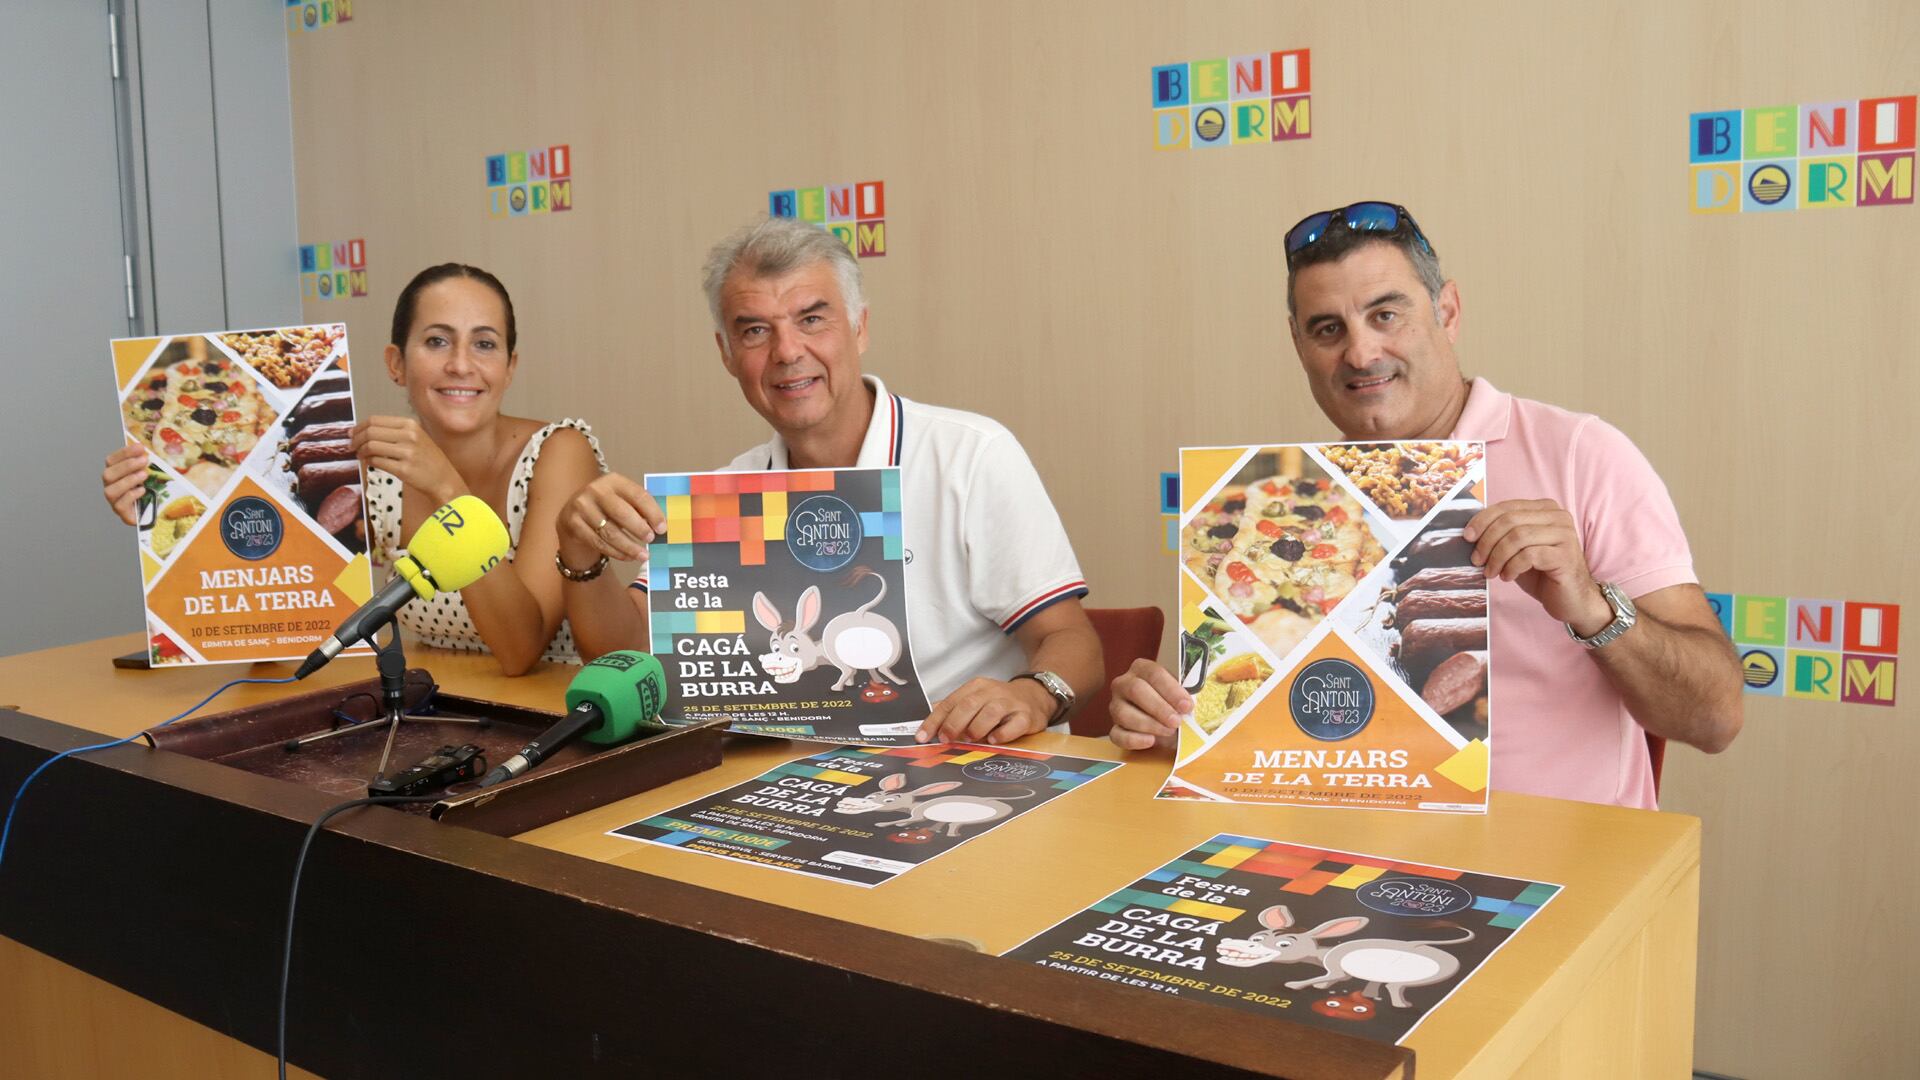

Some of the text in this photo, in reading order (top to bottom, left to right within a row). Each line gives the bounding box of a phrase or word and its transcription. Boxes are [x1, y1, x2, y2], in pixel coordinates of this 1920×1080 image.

[1157, 52, 1302, 105] BENI
[1157, 98, 1310, 146] DORM
[1697, 102, 1902, 158] BENI
[488, 147, 568, 184] BENI
[1695, 156, 1912, 208] DORM
[771, 183, 883, 220] BENI
[818, 508, 842, 521] SANT
[797, 514, 850, 545] ANTONI
[200, 565, 314, 589] MENJARS
[674, 573, 728, 588] Festa
[184, 589, 335, 615] DE LA TERRA
[675, 592, 723, 608] de la
[191, 620, 331, 637] 10 DE SETEMBRE DE 2022
[1707, 597, 1883, 648] ENI
[202, 639, 232, 649] ERMITA
[234, 638, 246, 647] DE
[277, 635, 323, 645] BENIDORM
[677, 635, 750, 656] CAGÁ
[679, 660, 758, 678] DE LA
[1741, 648, 1895, 700] ORM
[681, 680, 777, 698] BURRA
[1326, 673, 1351, 689] SANT
[703, 704, 719, 712] DE
[724, 701, 798, 711] SETEMBRE
[801, 701, 819, 709] DE
[822, 700, 853, 708] 2022
[1302, 678, 1360, 712] ANTONI
[830, 757, 883, 768] Festa
[841, 764, 862, 773] la
[1252, 750, 1408, 769] MENJARS
[778, 777, 853, 796] CAGÁ
[1221, 772, 1432, 788] DE LA TERRA
[753, 786, 831, 806] DE LA
[1268, 789, 1356, 798] SETEMBRE
[707, 811, 741, 820] PARTIR
[732, 794, 826, 817] BURRA
[690, 813, 725, 823] ERMITA
[772, 829, 828, 842] BENIDORM
[725, 807, 748, 815] DE
[746, 811, 820, 828] SETEMBRE
[818, 824, 840, 833] DE
[727, 833, 777, 848] 1000€
[686, 843, 803, 870] PREUS POPULARS
[759, 851, 791, 862] SERVEI
[791, 857, 807, 865] DE
[808, 861, 842, 871] BARRA
[1162, 885, 1227, 905] de la
[1175, 875, 1251, 897] Festa
[1122, 908, 1225, 936] CAGÁ
[1096, 920, 1206, 952] DE LA
[1072, 932, 1208, 971] BURRA
[1048, 961, 1098, 977] PARTIR
[1099, 972, 1121, 982] DE
[1120, 976, 1149, 988] LES
[1149, 982, 1163, 991] 12
[1048, 950, 1293, 1009] 25 DE SETEMBRE DE 2022
